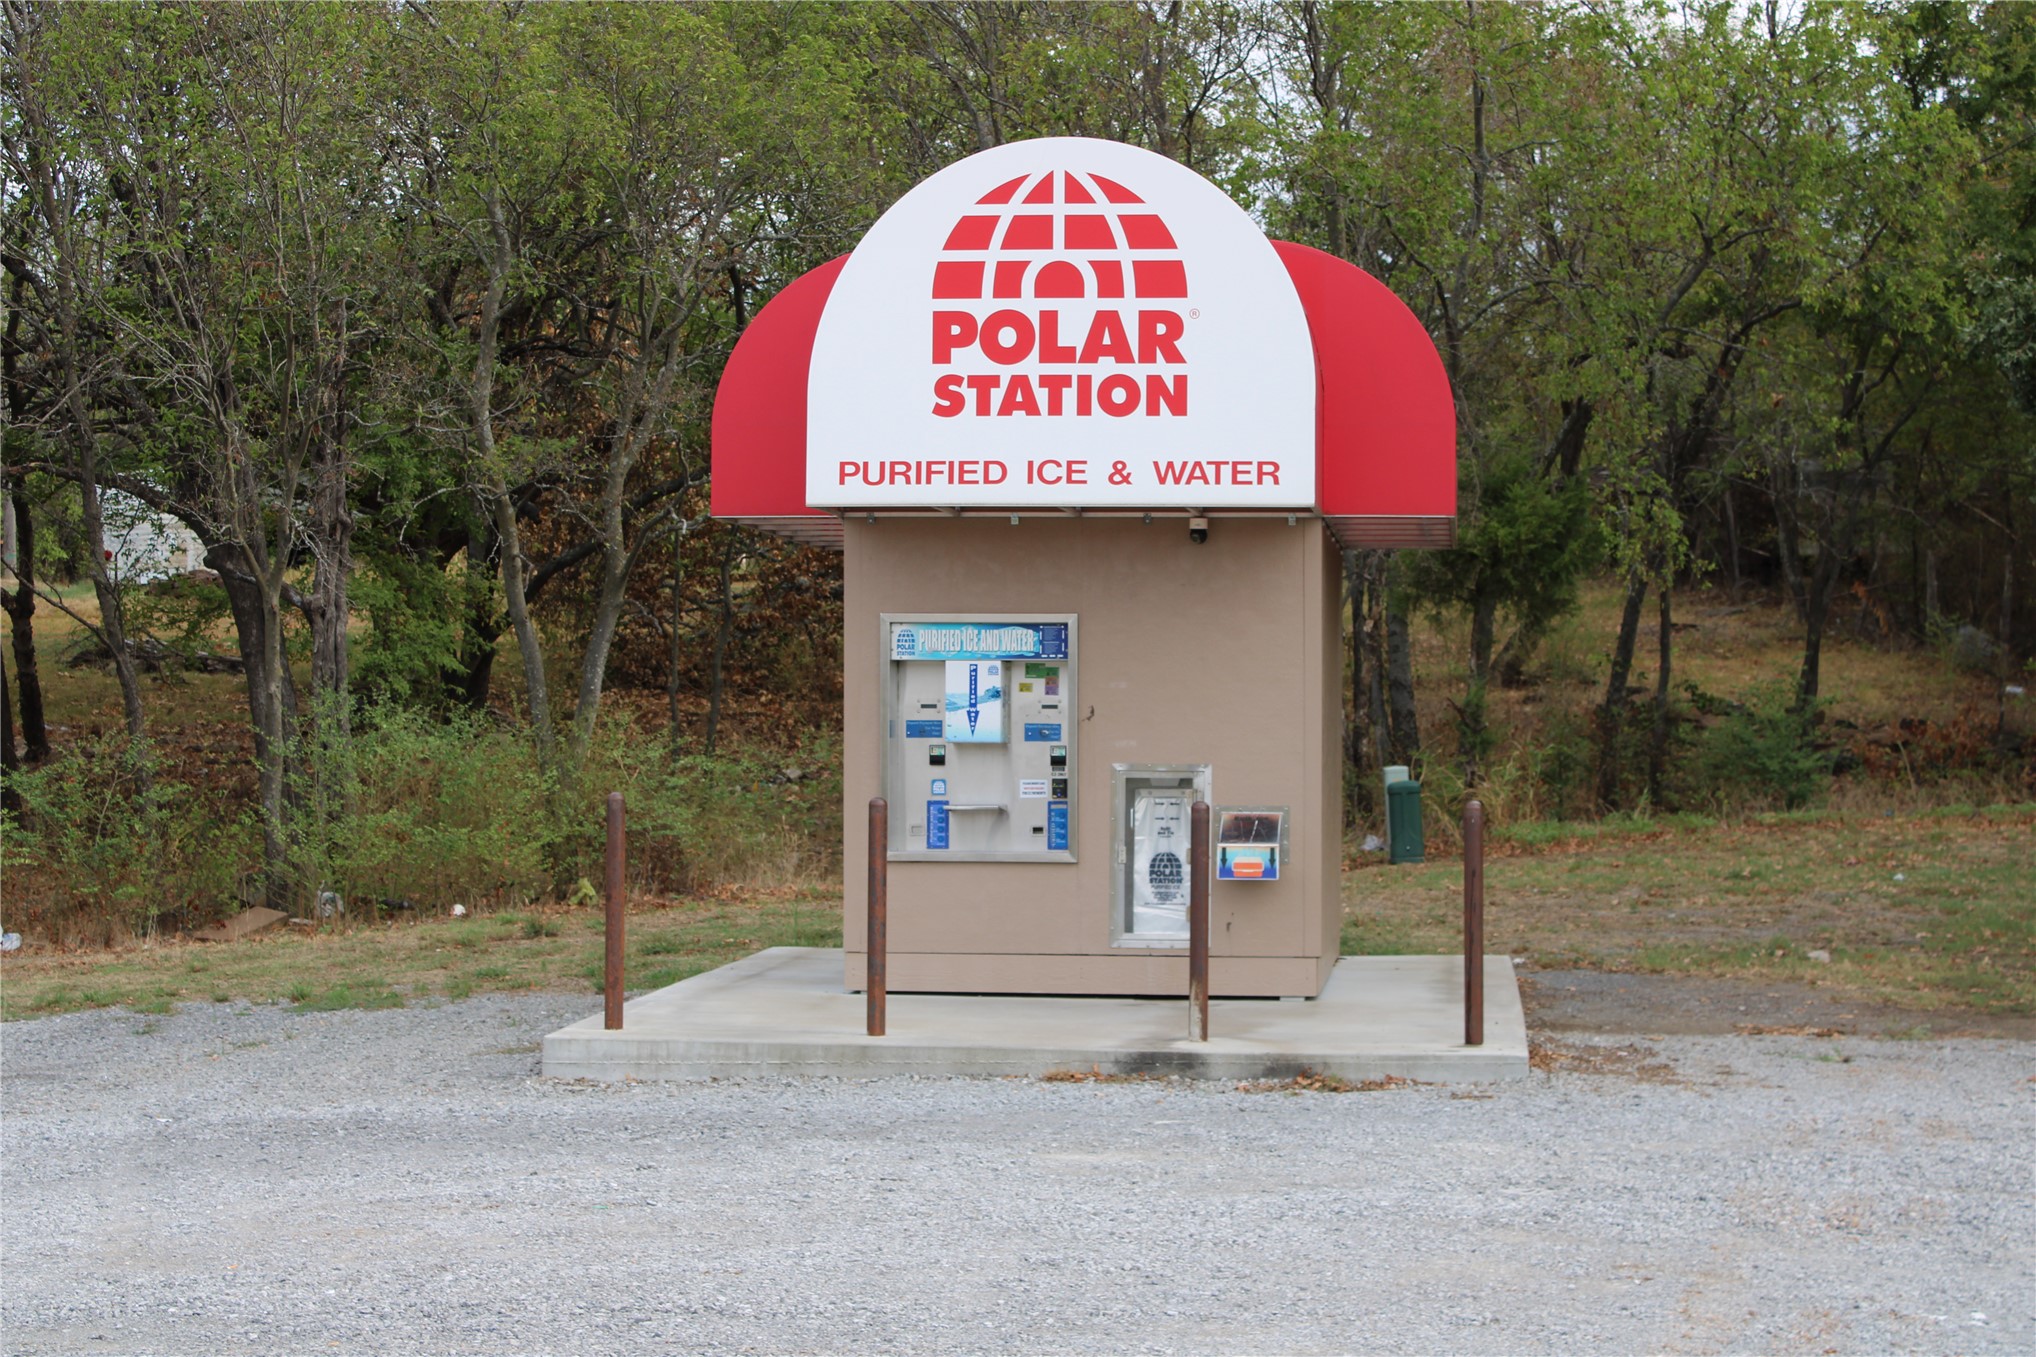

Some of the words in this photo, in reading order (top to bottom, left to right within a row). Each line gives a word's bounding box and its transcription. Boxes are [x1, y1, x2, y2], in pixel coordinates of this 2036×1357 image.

[932, 309, 1187, 365] POLAR
[931, 374, 1188, 417] STATION
[838, 460, 1008, 486] PURIFIED
[1027, 460, 1087, 485] ICE
[1108, 460, 1132, 485] &
[1153, 460, 1280, 486] WATER
[919, 629, 961, 652] PURIFIED
[962, 628, 979, 652] ICE
[980, 629, 1000, 652] AND
[1001, 629, 1035, 652] WATER
[1149, 869, 1182, 877] POLAR
